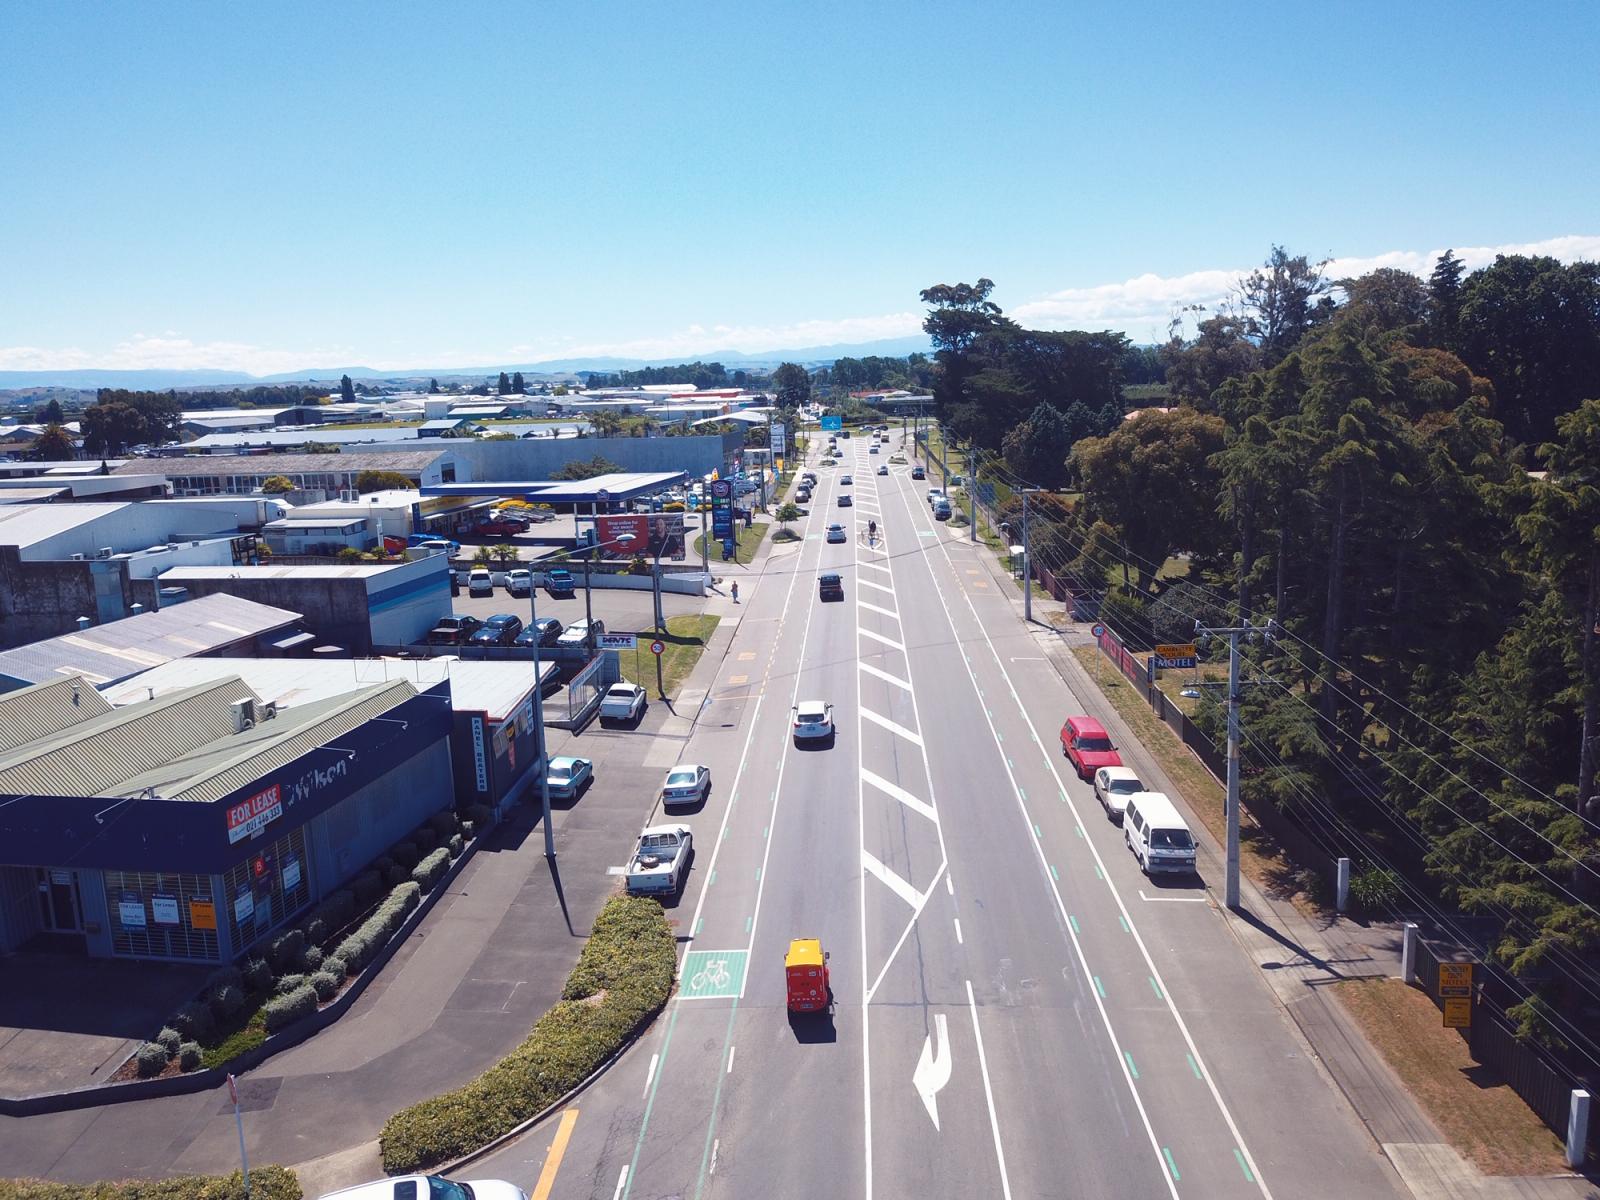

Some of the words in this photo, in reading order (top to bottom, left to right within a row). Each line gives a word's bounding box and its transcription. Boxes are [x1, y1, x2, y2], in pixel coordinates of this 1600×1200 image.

[1158, 658, 1191, 668] MOTEL
[476, 752, 485, 789] BEATERS
[231, 802, 251, 826] FOR
[252, 787, 278, 815] LEASE
[246, 819, 257, 832] 021
